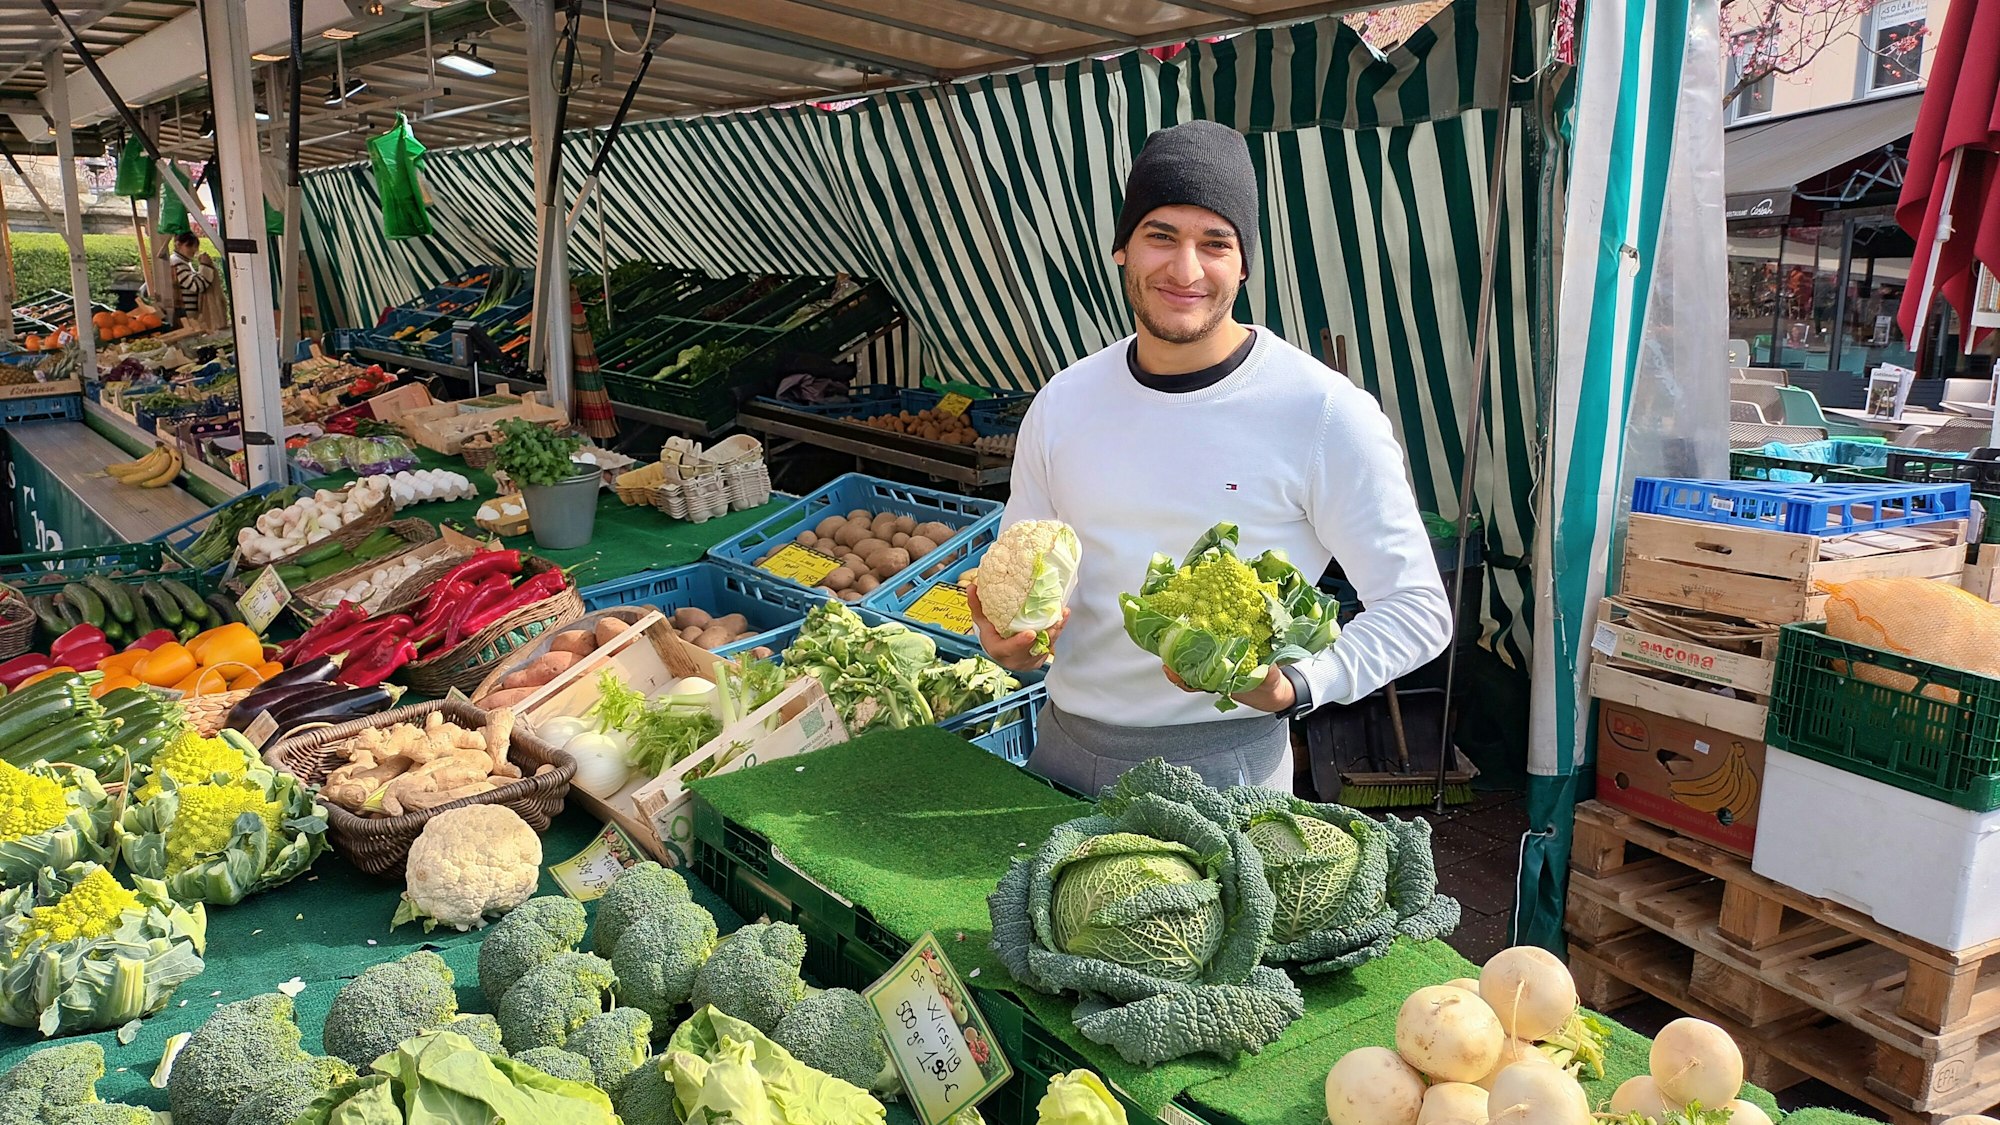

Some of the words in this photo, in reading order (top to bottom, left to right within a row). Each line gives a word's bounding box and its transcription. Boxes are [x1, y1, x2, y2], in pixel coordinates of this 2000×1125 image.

[1638, 640, 1715, 670] ancona
[1613, 717, 1645, 738] Dole
[926, 995, 962, 1073] Wirsing
